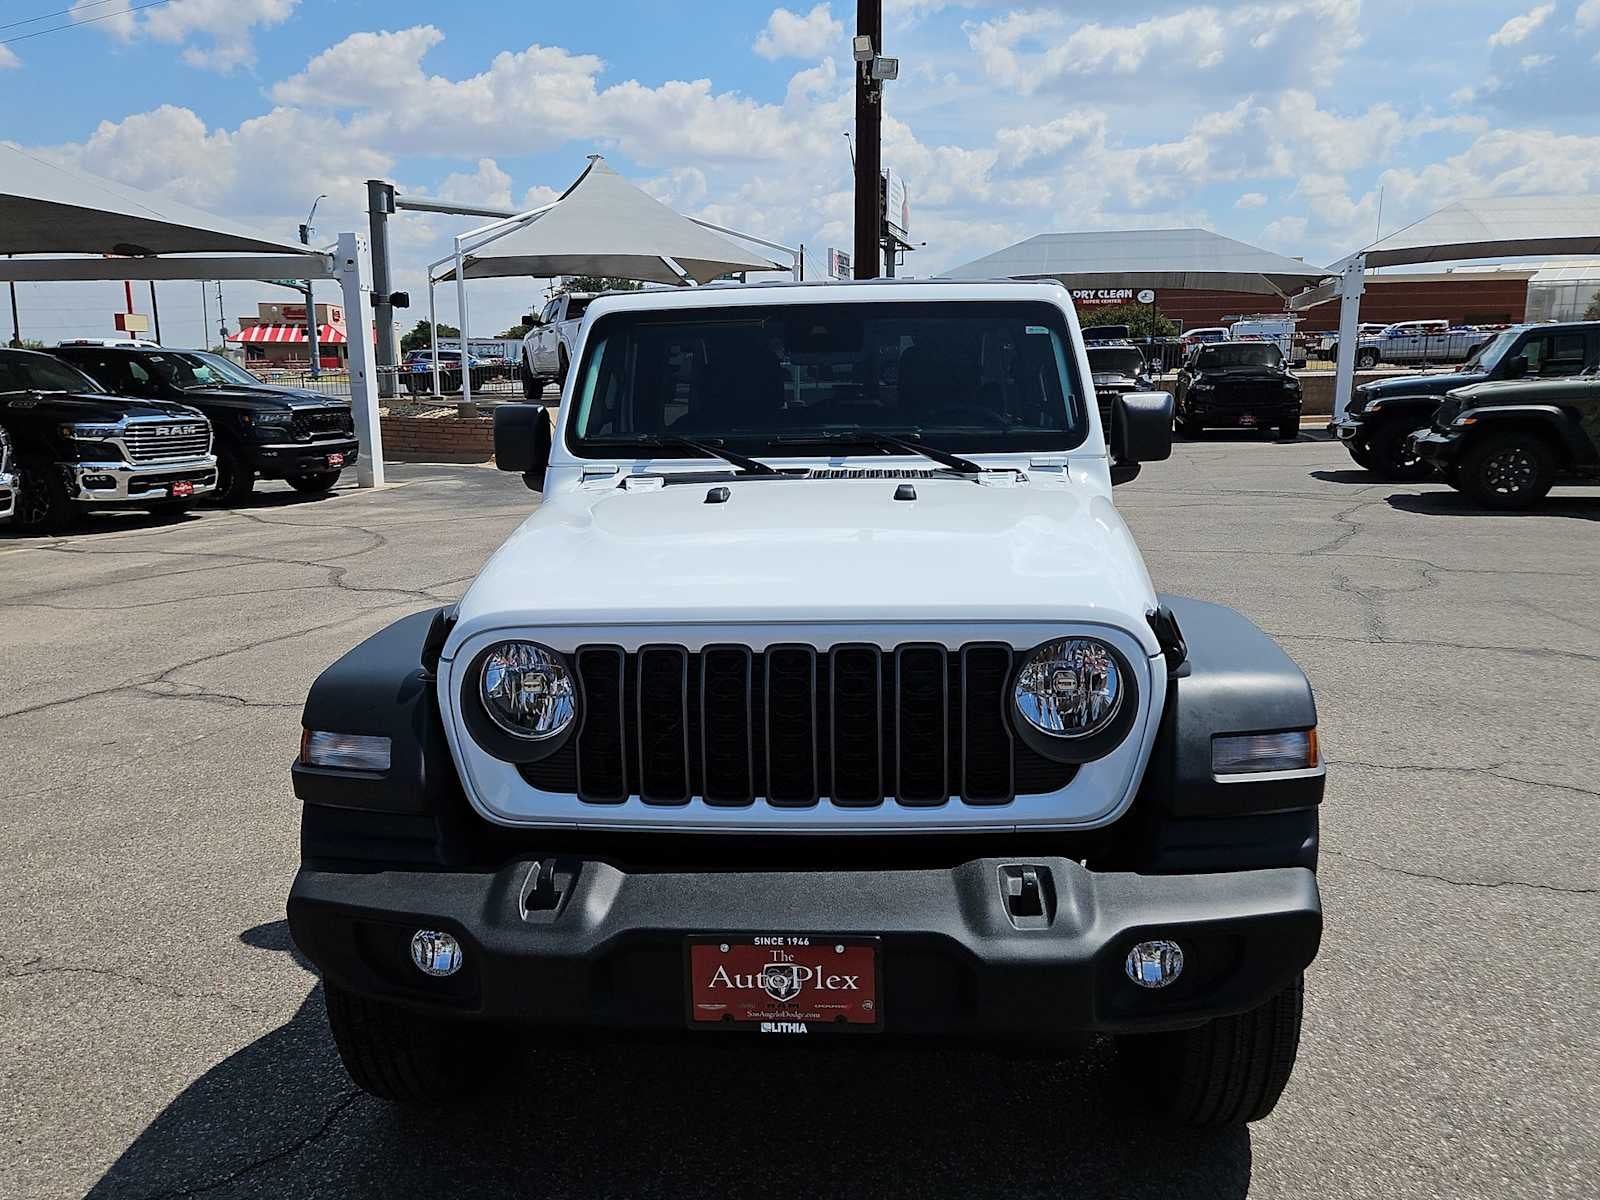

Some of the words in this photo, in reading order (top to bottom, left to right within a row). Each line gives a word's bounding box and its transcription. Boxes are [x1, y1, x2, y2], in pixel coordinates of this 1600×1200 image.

[1073, 289, 1095, 298] DRY
[1098, 289, 1132, 298] CLEAN
[155, 426, 195, 436] RAM
[754, 937, 784, 946] SINCE
[787, 937, 810, 946] 1946
[769, 950, 795, 962] The
[708, 964, 860, 991] AutoPlex
[771, 1022, 808, 1034] LITHIA
